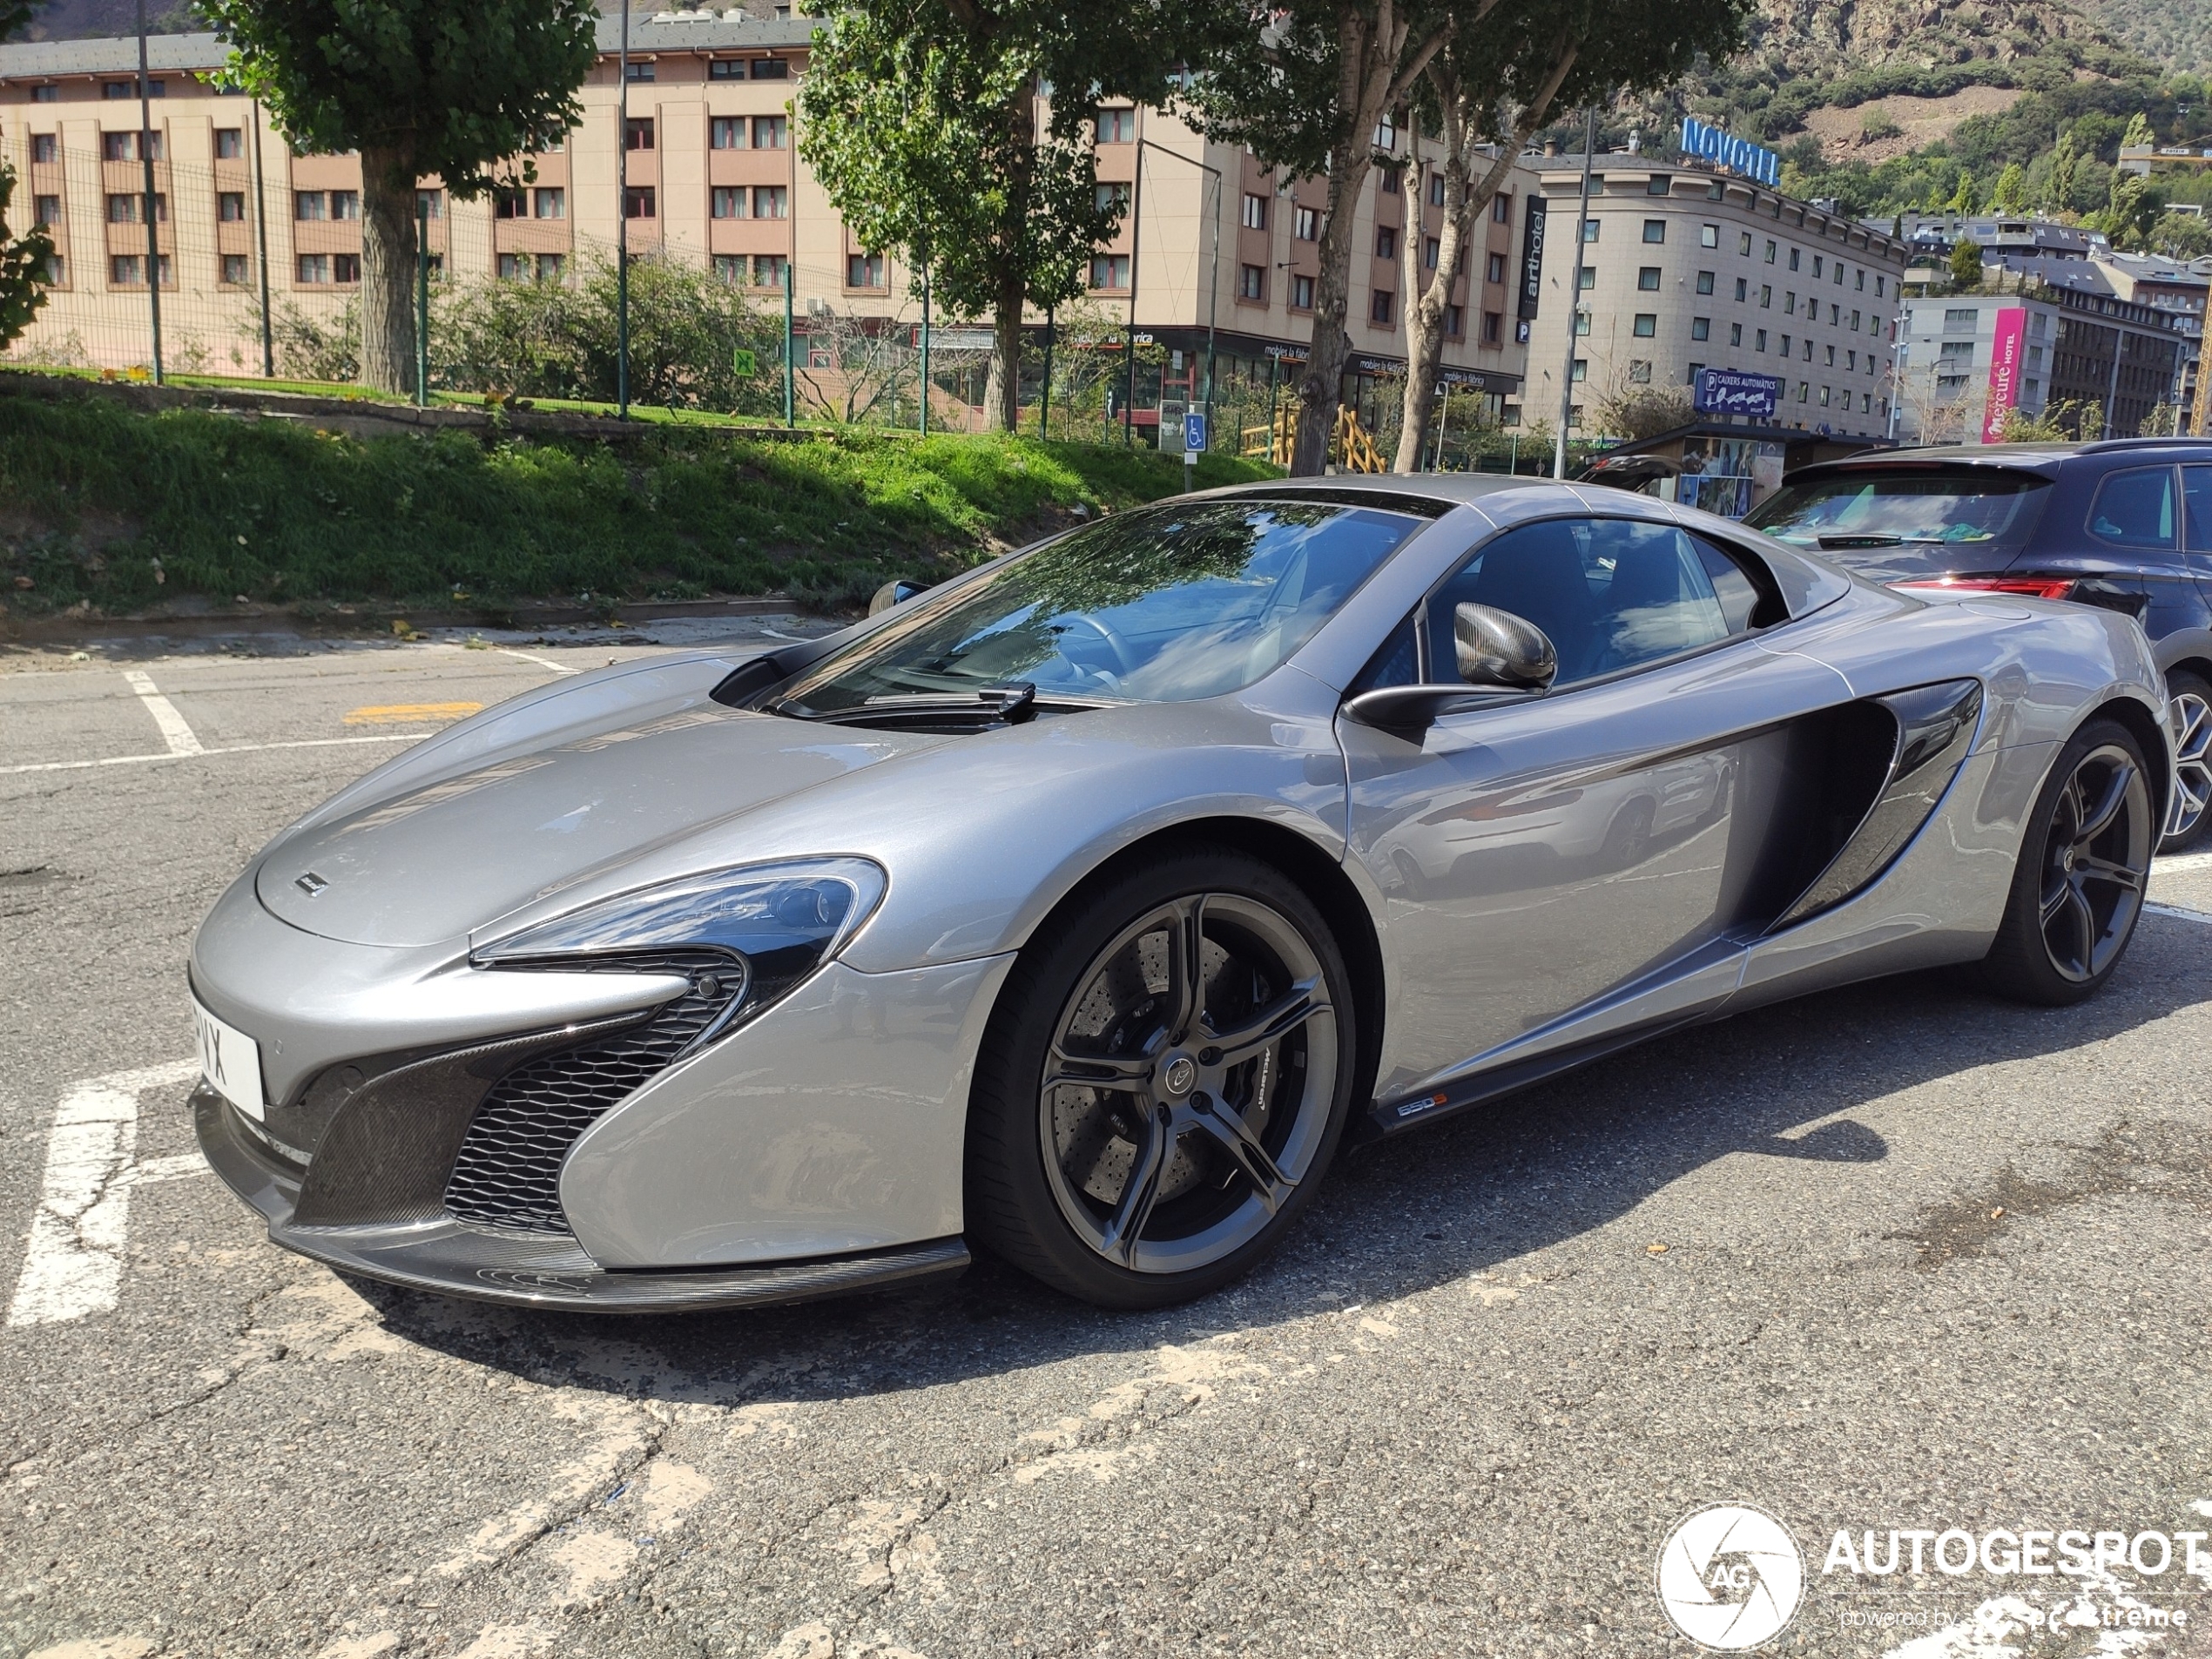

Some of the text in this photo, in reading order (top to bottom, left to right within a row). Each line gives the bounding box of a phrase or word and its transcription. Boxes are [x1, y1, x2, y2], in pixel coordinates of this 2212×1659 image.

[1682, 116, 1780, 186] NOVOTEL
[1528, 211, 1544, 297] arthotel
[1264, 345, 1287, 358] mobles
[1288, 347, 1295, 359] la
[2005, 333, 2015, 364] HOTEL
[1359, 359, 1380, 371] mobles
[1717, 374, 1740, 387] CAIXERS
